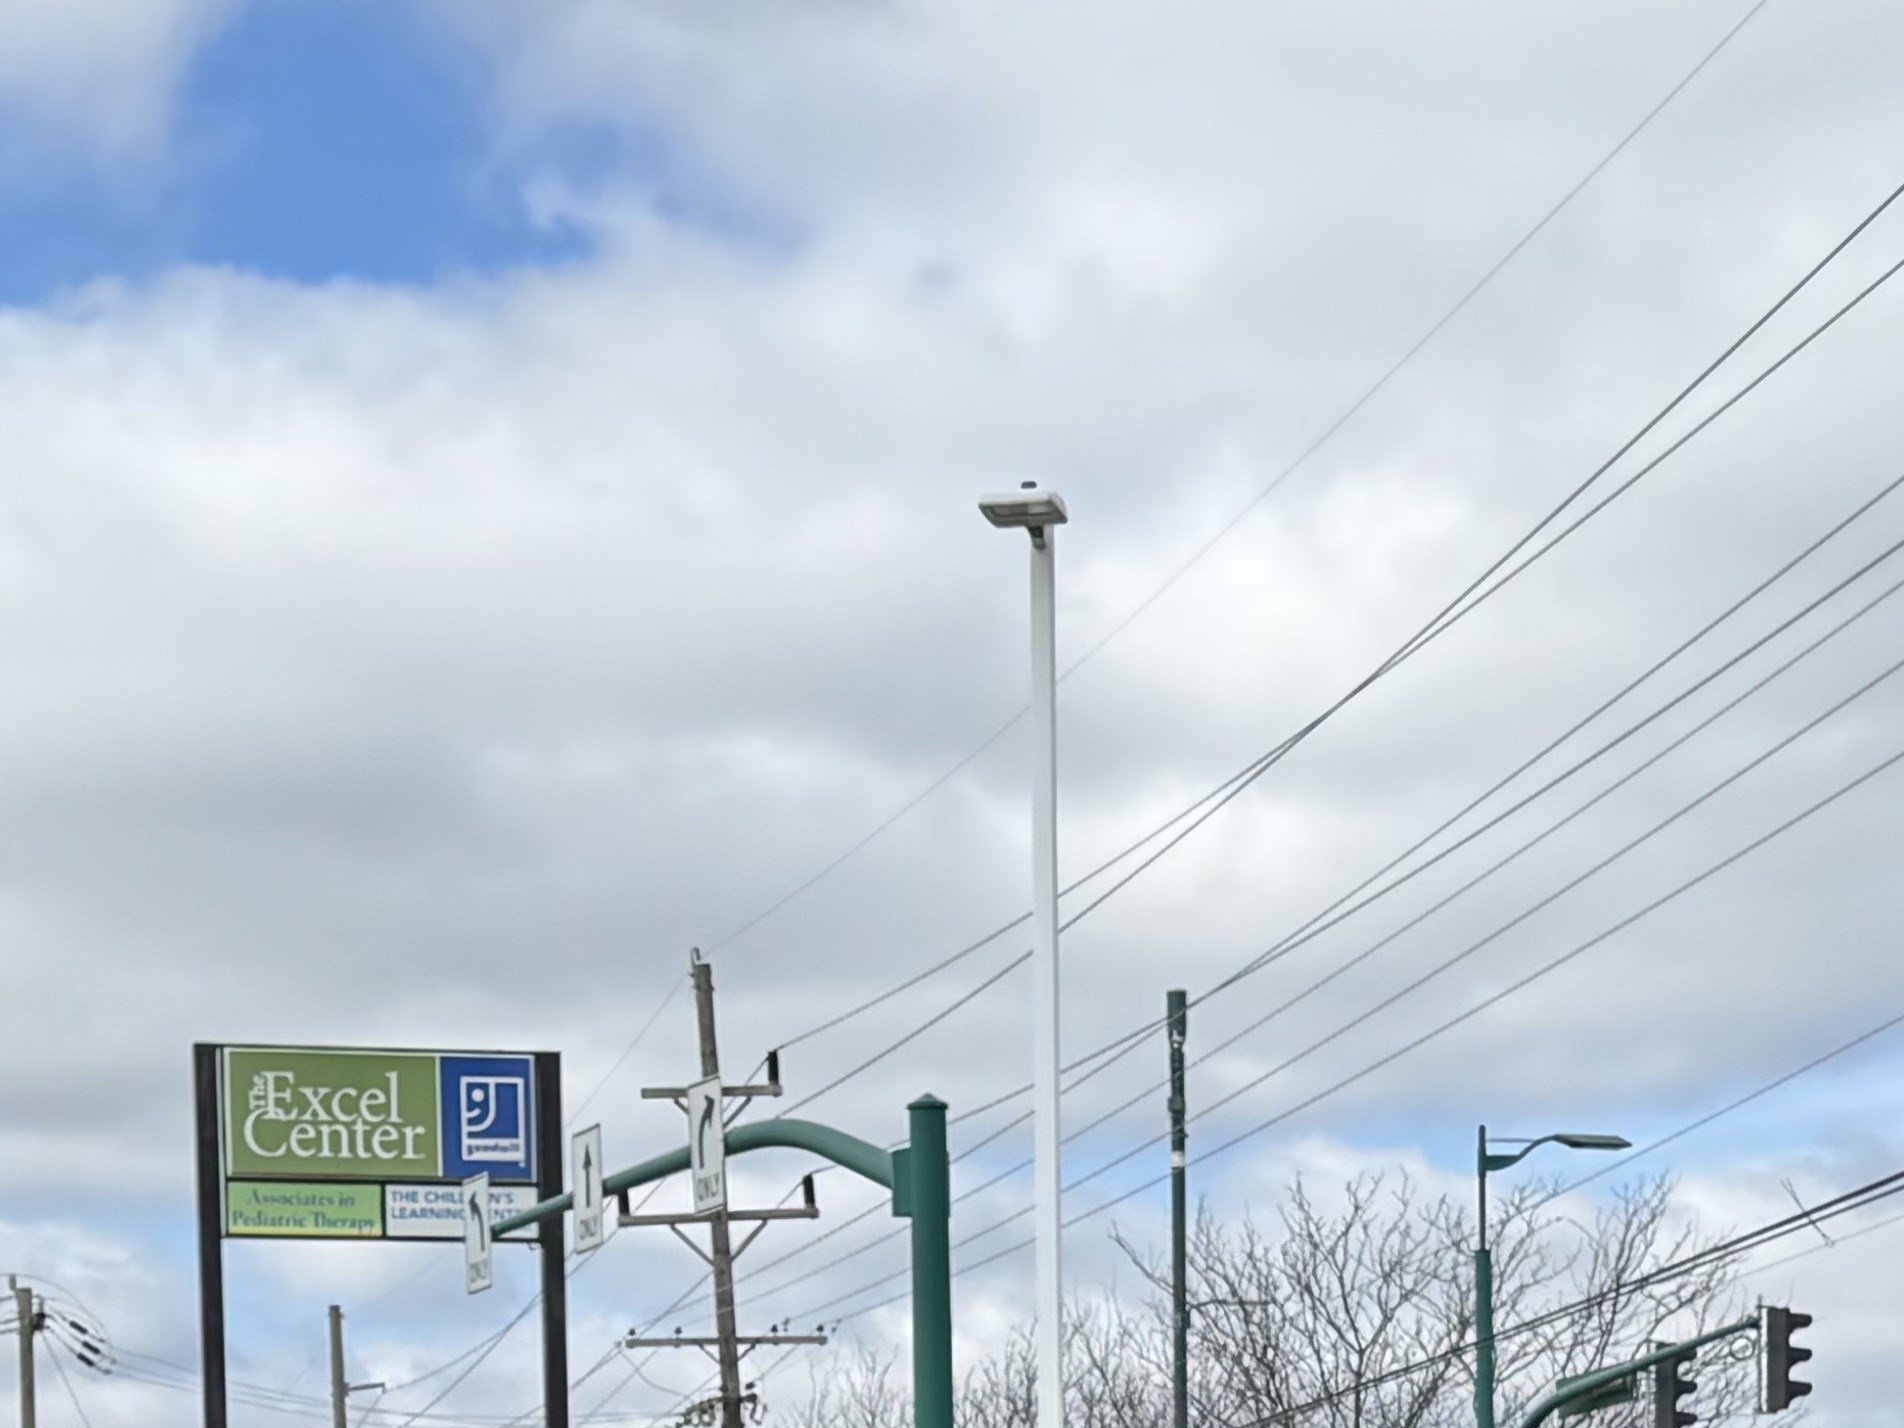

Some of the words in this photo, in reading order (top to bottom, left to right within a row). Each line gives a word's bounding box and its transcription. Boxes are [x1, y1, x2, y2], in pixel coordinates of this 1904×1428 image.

[261, 1070, 403, 1123] Excel
[243, 1106, 426, 1160] Center
[250, 1189, 334, 1207] Associates
[338, 1193, 356, 1207] in
[391, 1191, 419, 1203] THE
[232, 1210, 307, 1228] Pediatric
[311, 1212, 376, 1236] Therapy
